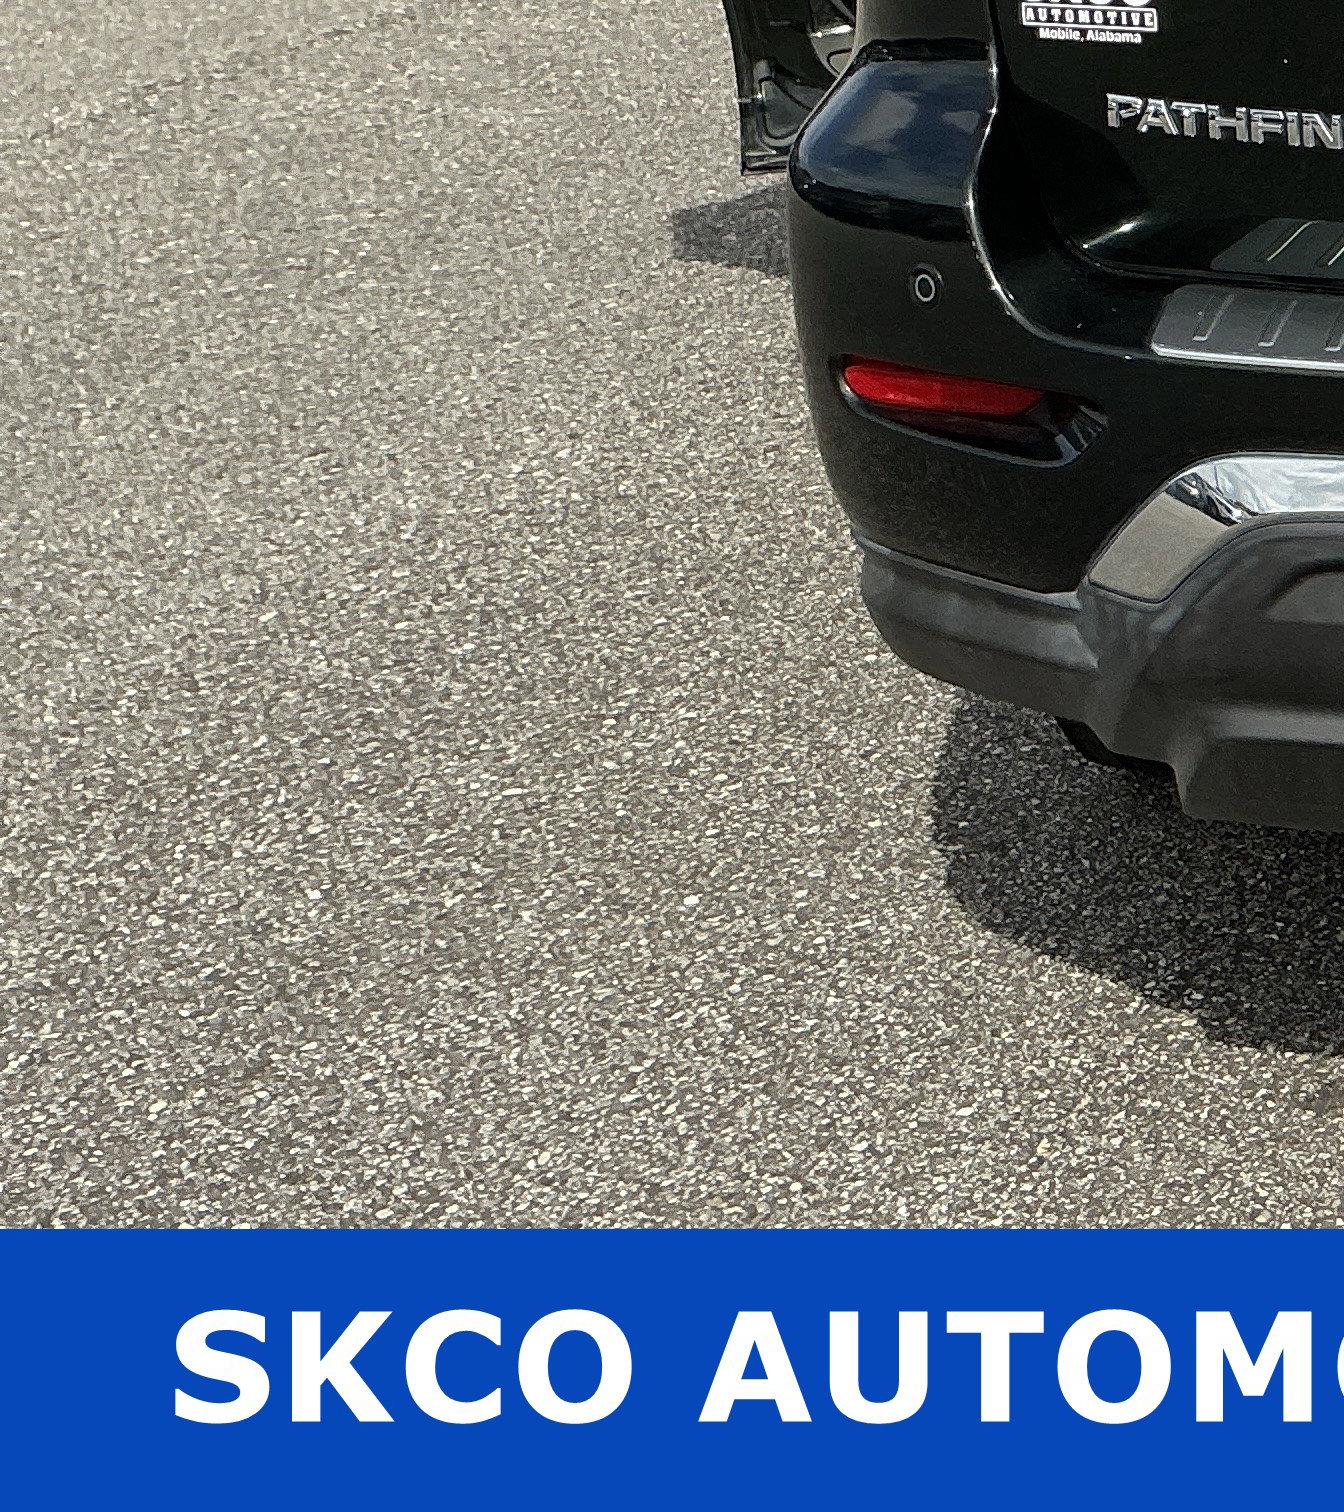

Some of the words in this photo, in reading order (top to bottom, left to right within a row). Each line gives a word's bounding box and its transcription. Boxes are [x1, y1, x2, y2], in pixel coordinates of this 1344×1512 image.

[1025, 6, 1155, 27] AUTOMOTIVE
[1038, 27, 1084, 42] Mobile,
[1087, 30, 1142, 44] Alabama
